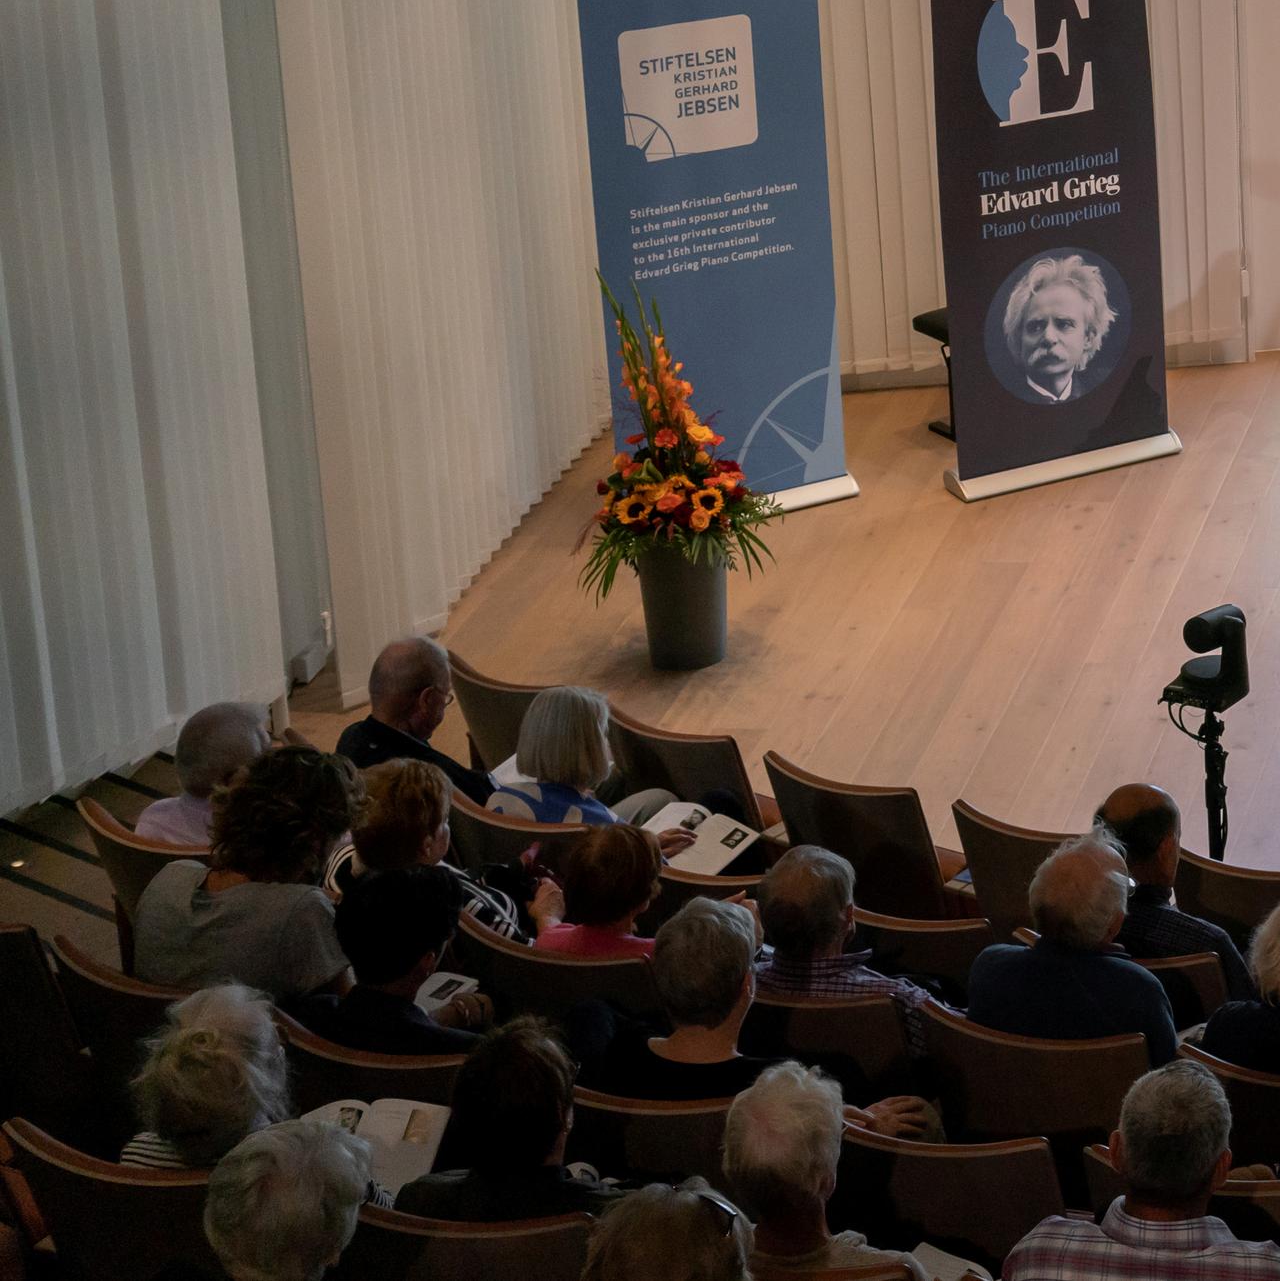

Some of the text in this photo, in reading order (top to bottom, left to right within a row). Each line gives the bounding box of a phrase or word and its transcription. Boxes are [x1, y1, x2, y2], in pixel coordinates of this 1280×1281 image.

[639, 47, 736, 76] STIFTELSEN
[674, 65, 737, 84] KRISTIAN
[675, 80, 738, 99] GERHARD
[677, 94, 739, 118] JEBSEN
[978, 147, 1120, 188] The International
[630, 182, 798, 219] Stiftelsen Kristian Gerhard Jebsen
[980, 174, 1121, 216] Edvard Grieg
[631, 202, 768, 234] is the main sponsor and the
[632, 216, 777, 250] exclusive private contributor
[983, 201, 1121, 240] Piano Competition
[634, 233, 759, 265] to the 16th International
[635, 243, 794, 280] Edvard Grieg Piano Competition.
